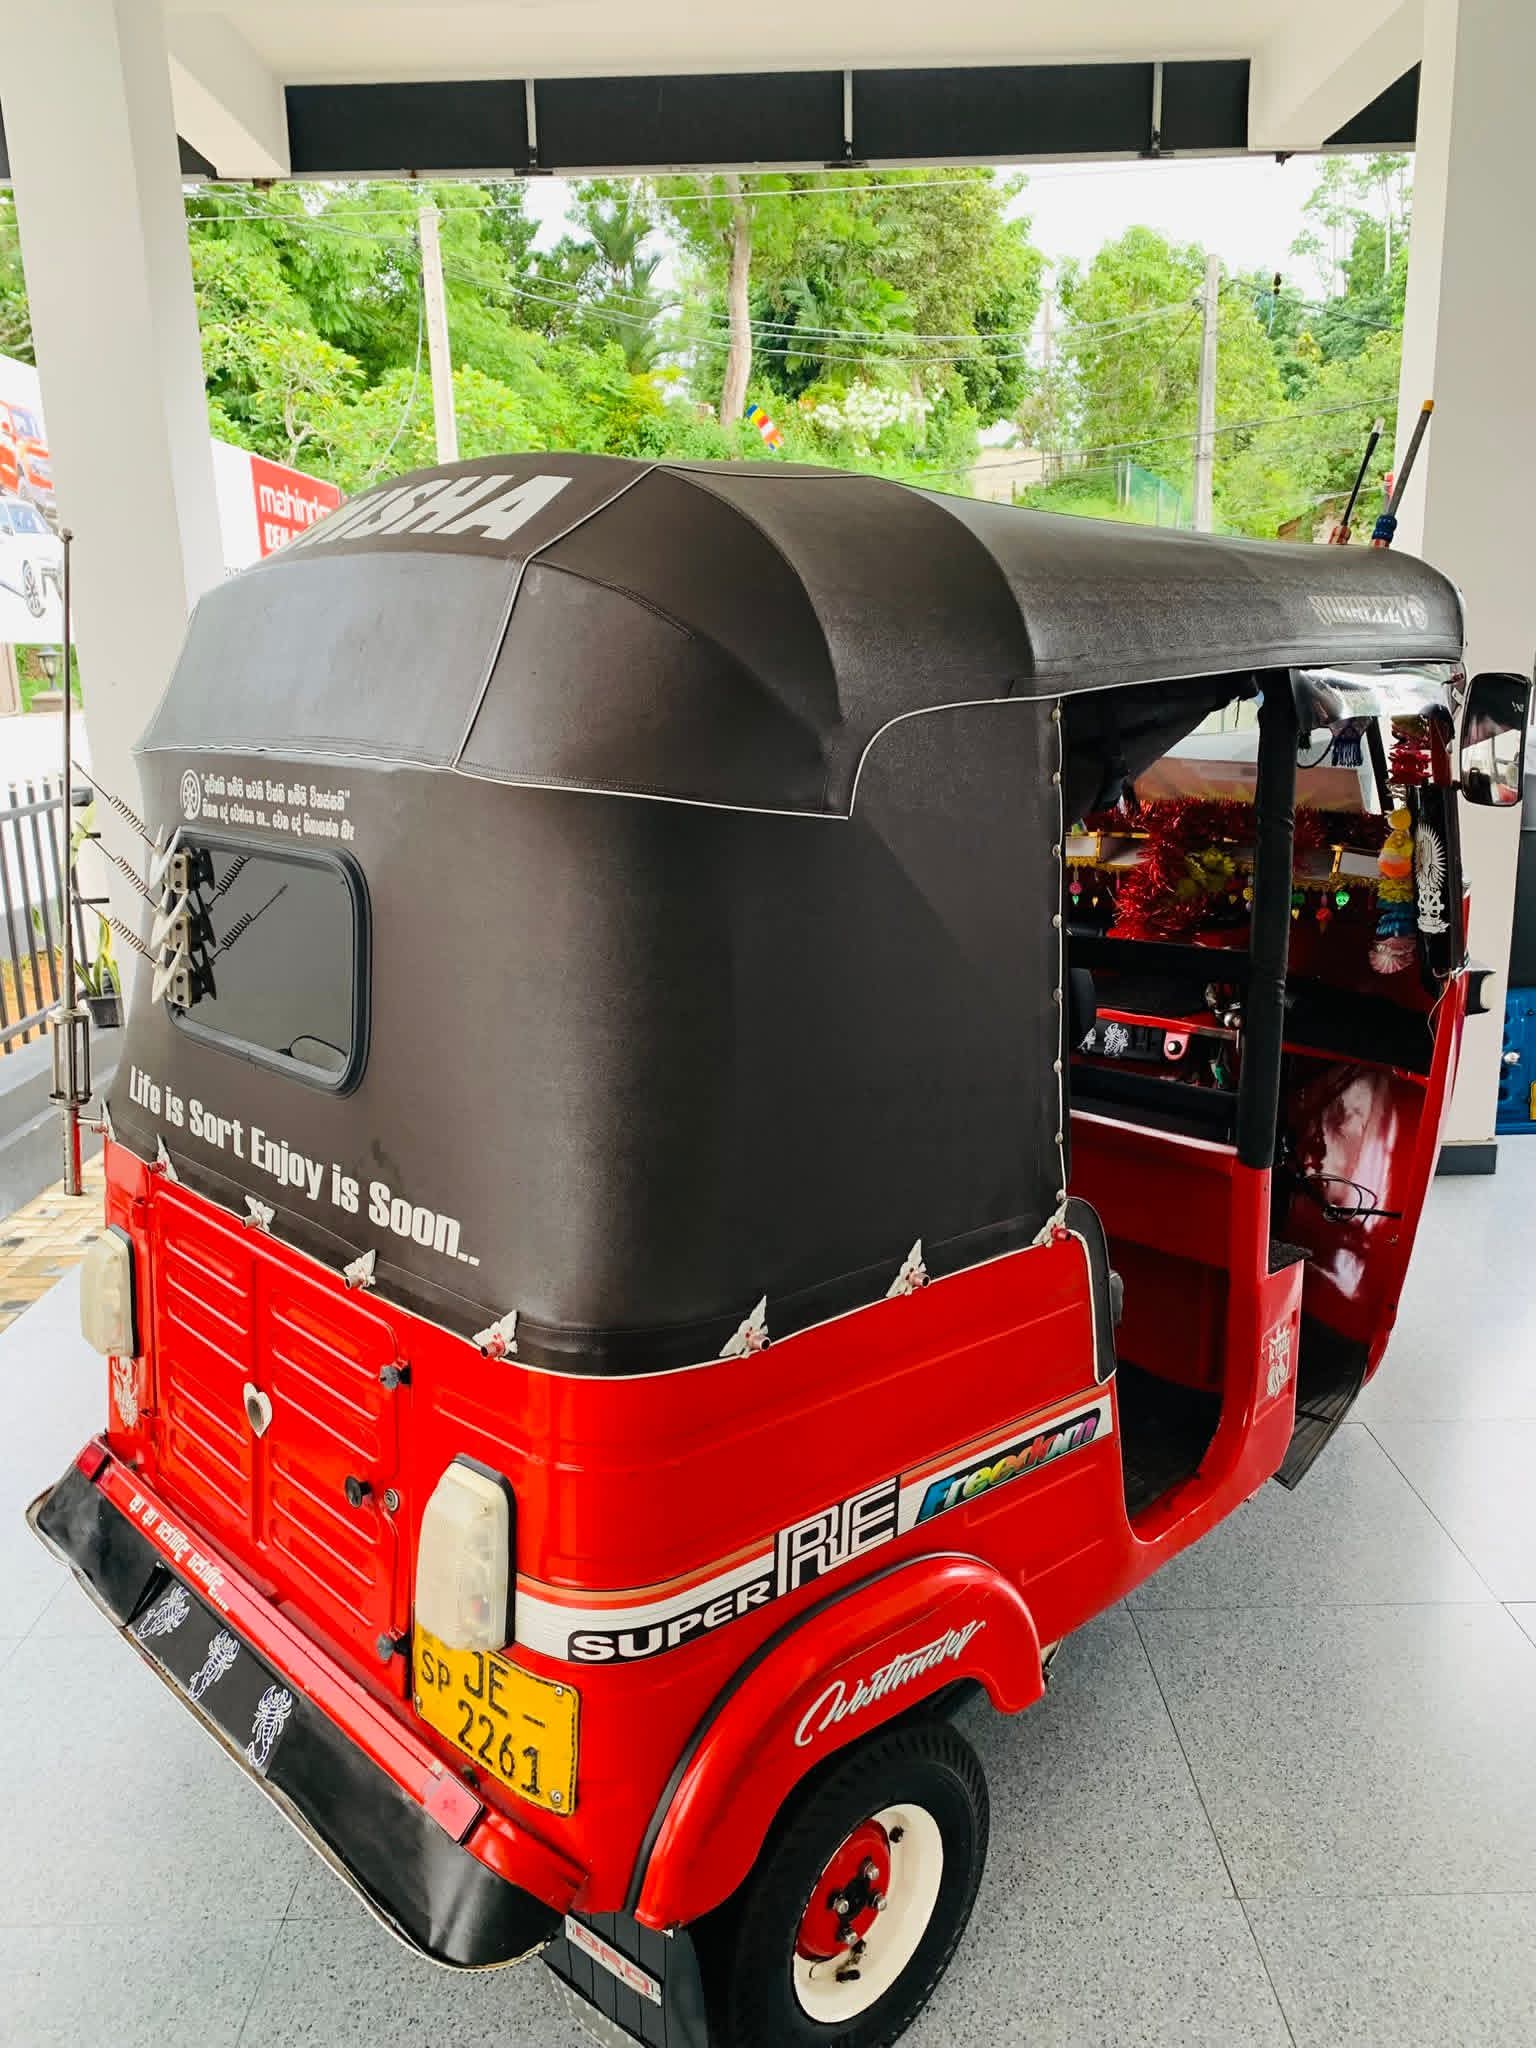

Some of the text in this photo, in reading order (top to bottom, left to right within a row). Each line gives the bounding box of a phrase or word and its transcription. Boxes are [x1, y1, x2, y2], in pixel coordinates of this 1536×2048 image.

[129, 1065, 161, 1115] Life
[165, 1086, 184, 1127] is
[189, 1099, 244, 1159] Sort
[251, 1125, 324, 1202] Enjoy
[331, 1163, 359, 1214] is
[570, 1416, 1098, 1661] SUPER RE Freedom
[457, 1699, 541, 1796] 2261
